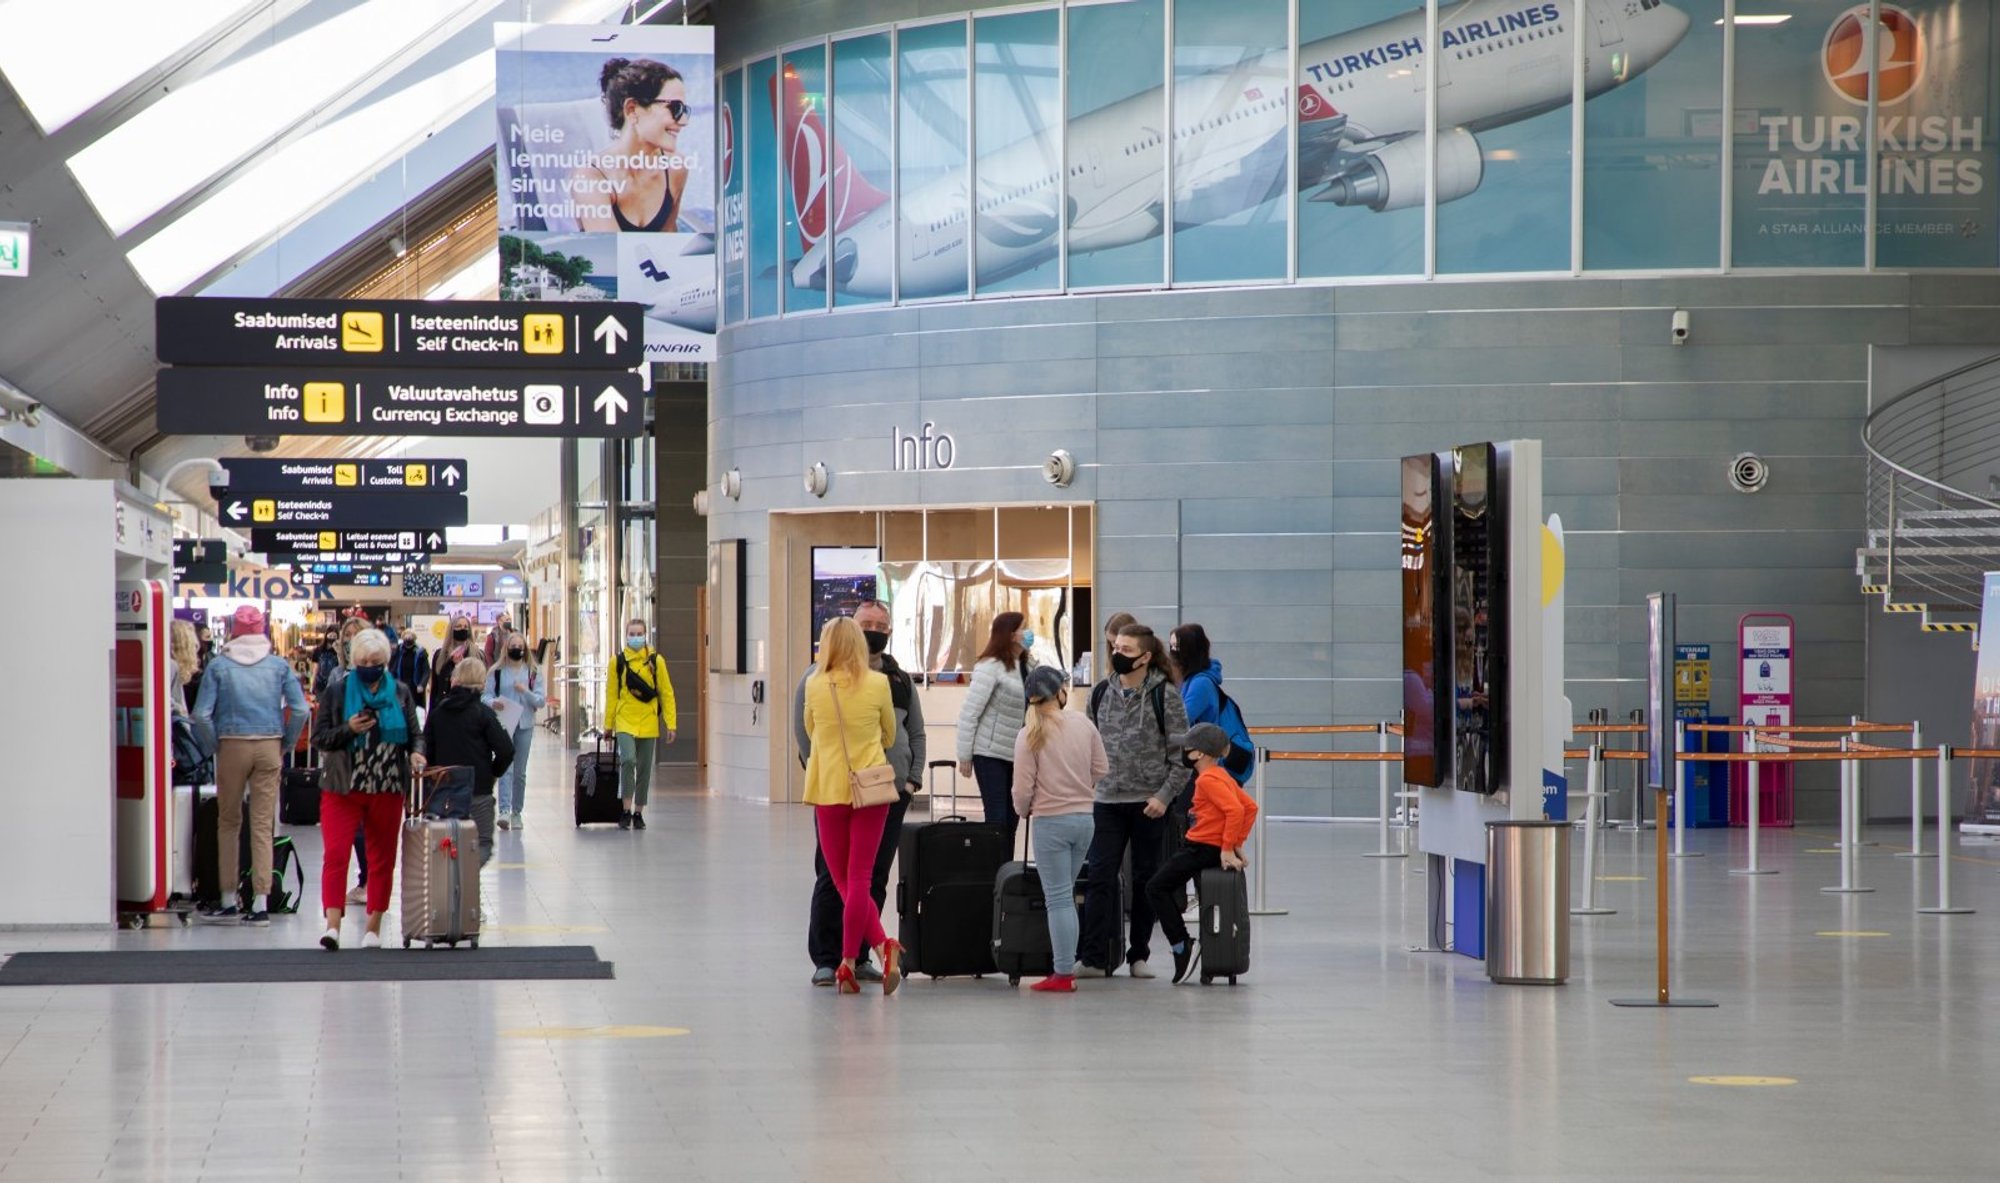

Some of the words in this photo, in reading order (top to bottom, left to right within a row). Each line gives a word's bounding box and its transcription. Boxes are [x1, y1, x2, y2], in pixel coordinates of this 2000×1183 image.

[1306, 37, 1423, 83] TURKISH
[1442, 3, 1560, 49] AIRLINES
[510, 124, 564, 143] Meie
[1759, 116, 1983, 151] TURKISH
[511, 148, 702, 173] lennuühendused,
[511, 174, 556, 194] sinu
[559, 174, 627, 194] värav
[1757, 159, 1983, 195] AIRLINES
[512, 199, 612, 219] maailma
[725, 193, 743, 227] KISH
[1759, 224, 1767, 234] A
[1772, 224, 1809, 234] STAR
[1895, 224, 1954, 234] MEMBER
[234, 312, 338, 329] Saabumised
[410, 315, 518, 331] Iseteenindus
[275, 335, 338, 350] Arrivals
[416, 336, 447, 351] Self
[451, 337, 518, 352] Check-In
[643, 343, 702, 354] INNAIR
[264, 384, 298, 400] Info
[388, 385, 518, 402] Valuutavahetus
[268, 406, 299, 420] Info
[372, 406, 441, 425] Currency
[445, 407, 518, 426] Exchange
[892, 421, 956, 471] Info
[281, 465, 333, 475] Saabumised
[386, 465, 403, 475] Toll
[302, 476, 333, 485] Arrivals
[370, 476, 403, 486] Customs
[277, 500, 333, 510] Iseteenindus
[277, 511, 294, 520] Self
[276, 532, 318, 541] Saabumised
